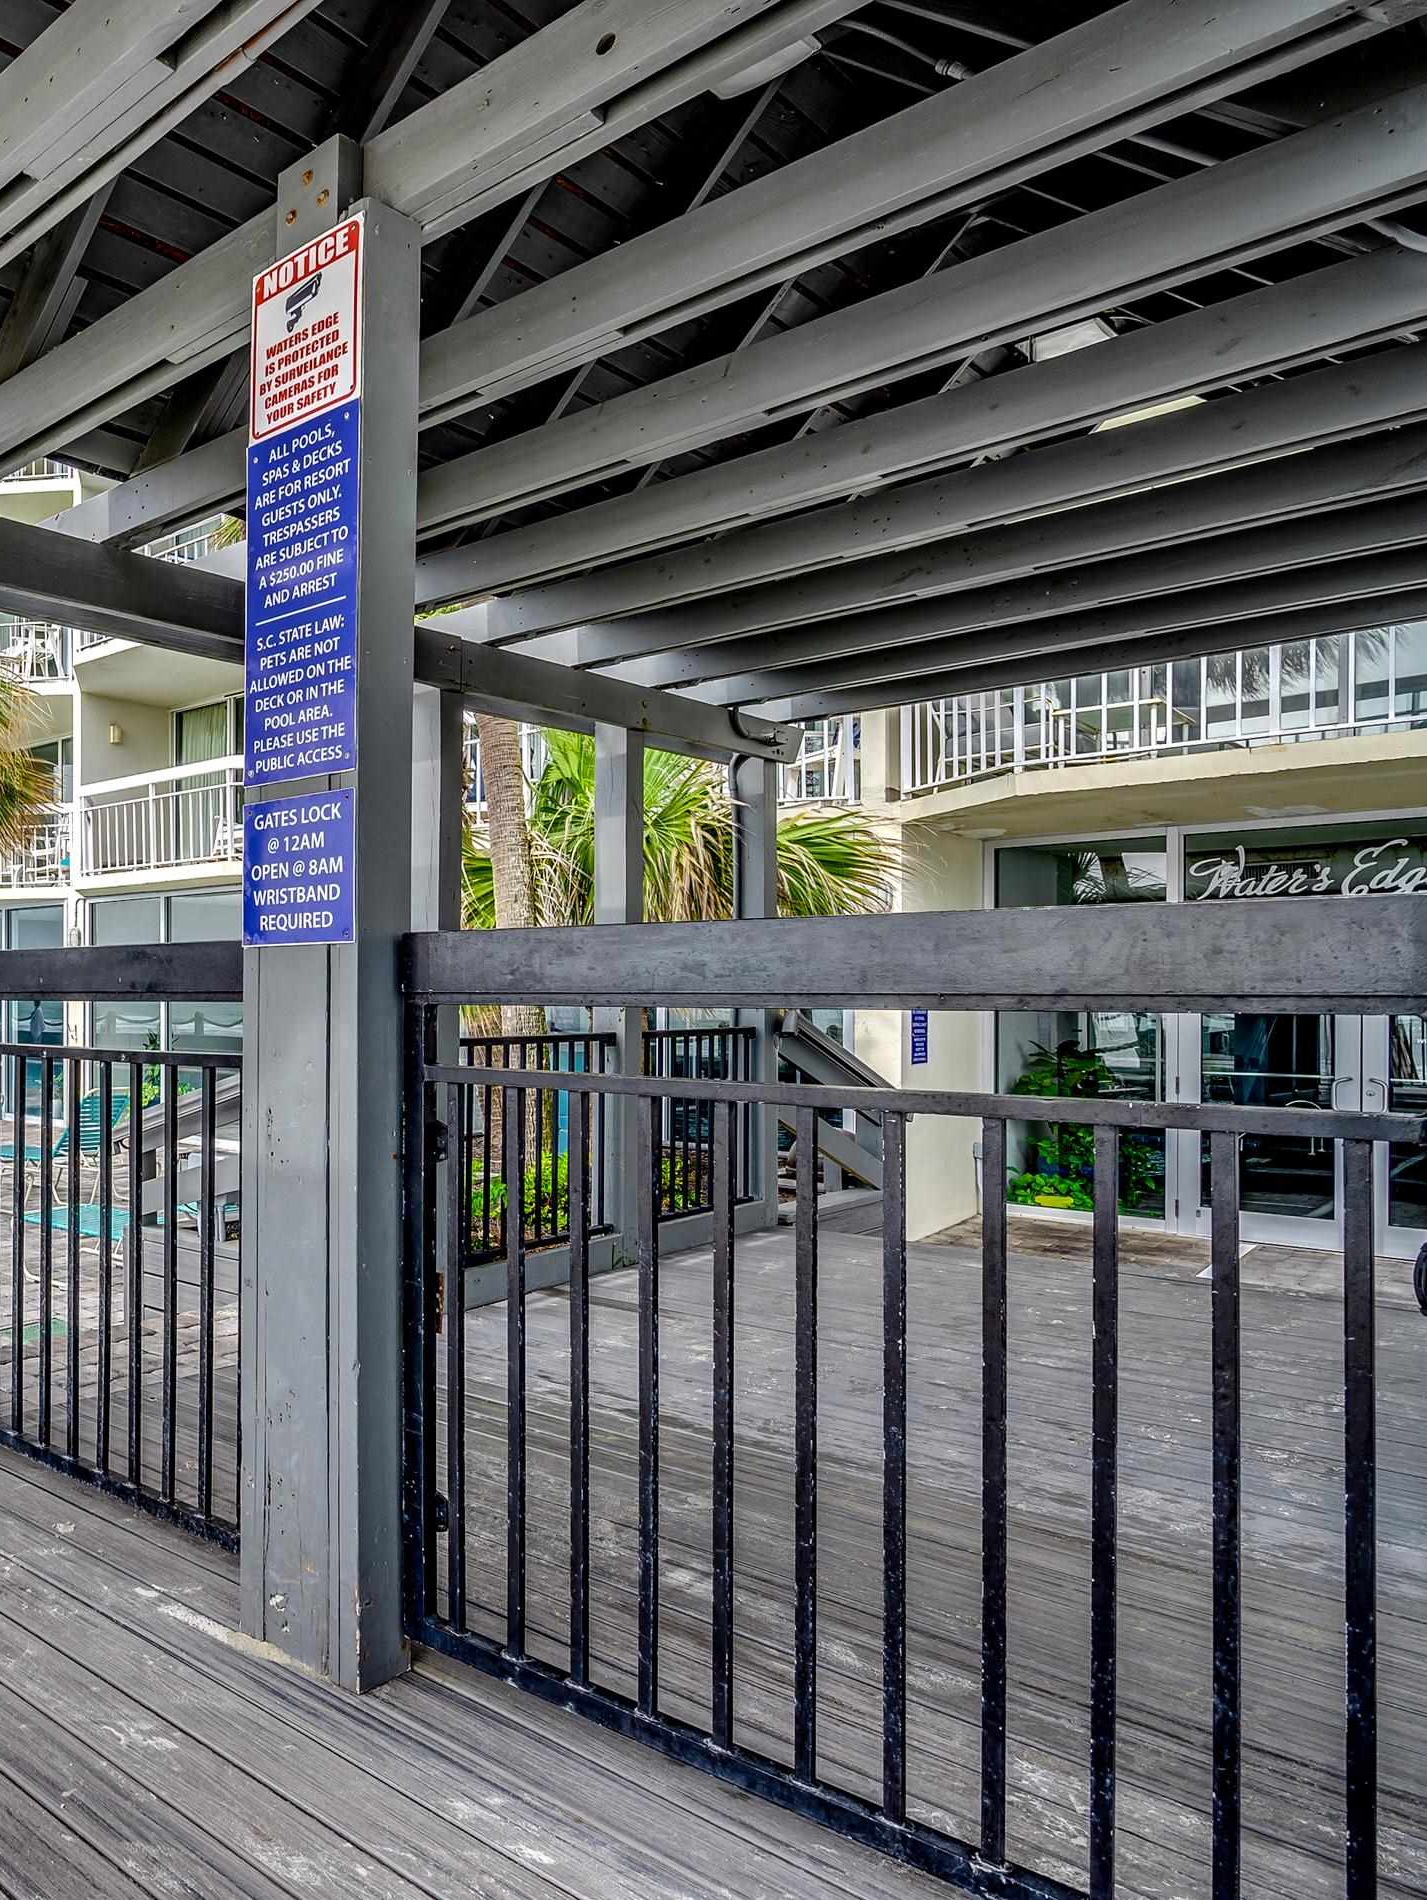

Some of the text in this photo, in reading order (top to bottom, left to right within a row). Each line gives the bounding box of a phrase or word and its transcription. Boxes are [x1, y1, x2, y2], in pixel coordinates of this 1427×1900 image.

[263, 226, 349, 300] NOTICE
[265, 329, 339, 377] IS PROTECTED
[266, 311, 339, 360] WATERS EDGE
[260, 341, 348, 396] BY SURVEILANCE
[265, 364, 339, 410] CAMERAS FOR
[266, 381, 336, 425] YOUR SAFETY
[262, 440, 342, 486] SPAS & DECKS
[269, 423, 335, 463] ALL POOLS,
[254, 458, 351, 511] ARE FOR RESORT
[261, 484, 342, 527] GUESTS ONLY.
[262, 506, 341, 547] TRESPASSERS
[255, 525, 348, 571] ARE SUBJECT TO
[259, 548, 344, 590] A $250.00 FINE
[264, 572, 337, 609] AND ARREST
[257, 614, 345, 652] S.C. STATE LAW:
[260, 636, 341, 671] PETS ARE NOT
[250, 655, 351, 694] ALLOWED ON THE
[255, 679, 345, 713] DECK OR IN THE
[265, 704, 333, 731] POOL AREA.
[254, 722, 345, 754] PLEASE USE THE
[255, 744, 343, 773] PUBLIC ACCESS
[254, 802, 342, 831] GATES LOCK
[267, 831, 325, 854] @ 12AM
[251, 855, 343, 881] OPEN @ 8AM
[1188, 838, 1427, 901] Water's Edg
[253, 883, 341, 907] WRISTBAND
[260, 911, 333, 932] REQUIRED
